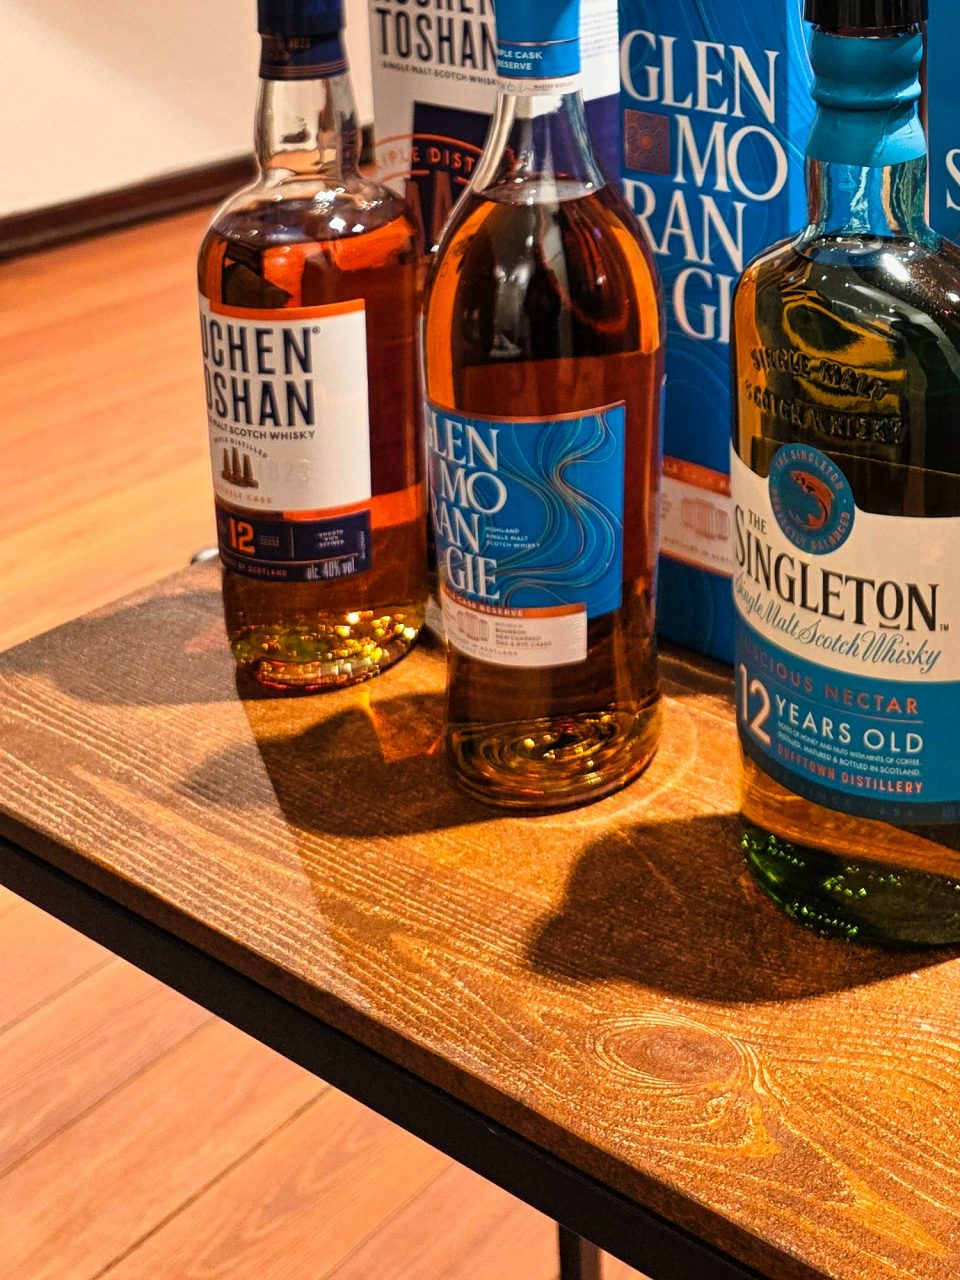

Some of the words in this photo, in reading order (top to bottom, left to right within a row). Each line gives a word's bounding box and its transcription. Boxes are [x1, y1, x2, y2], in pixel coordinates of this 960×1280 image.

[412, 66, 432, 76] MALT
[434, 69, 467, 81] SCOTCH
[515, 51, 543, 60] CASK
[620, 29, 780, 124] GLEN
[673, 114, 788, 201] MO
[229, 425, 267, 439] SCOTCH
[269, 430, 315, 440] WHISKY
[440, 459, 507, 514] MO
[790, 449, 844, 490] SINGLETON
[228, 517, 256, 554] 12
[749, 514, 767, 535] THE
[306, 564, 320, 580] alc.
[323, 560, 340, 578] 40%
[343, 556, 357, 573] vol.
[446, 546, 501, 600] GIE
[735, 504, 940, 632] SINGLETON
[480, 604, 524, 617] RESERVE
[760, 600, 800, 640] Malt
[797, 619, 859, 657] Scotch
[862, 630, 941, 674] Whisky
[739, 661, 771, 746] 12
[775, 694, 851, 744] YEARS
[863, 727, 923, 754] OLD
[824, 682, 918, 715] NECTAR
[804, 745, 832, 762] MATURED
[839, 759, 868, 771] BOTTLED
[820, 741, 832, 751] AND
[778, 744, 835, 780] DUFFTOWN
[842, 774, 923, 794] DISTILLERY
